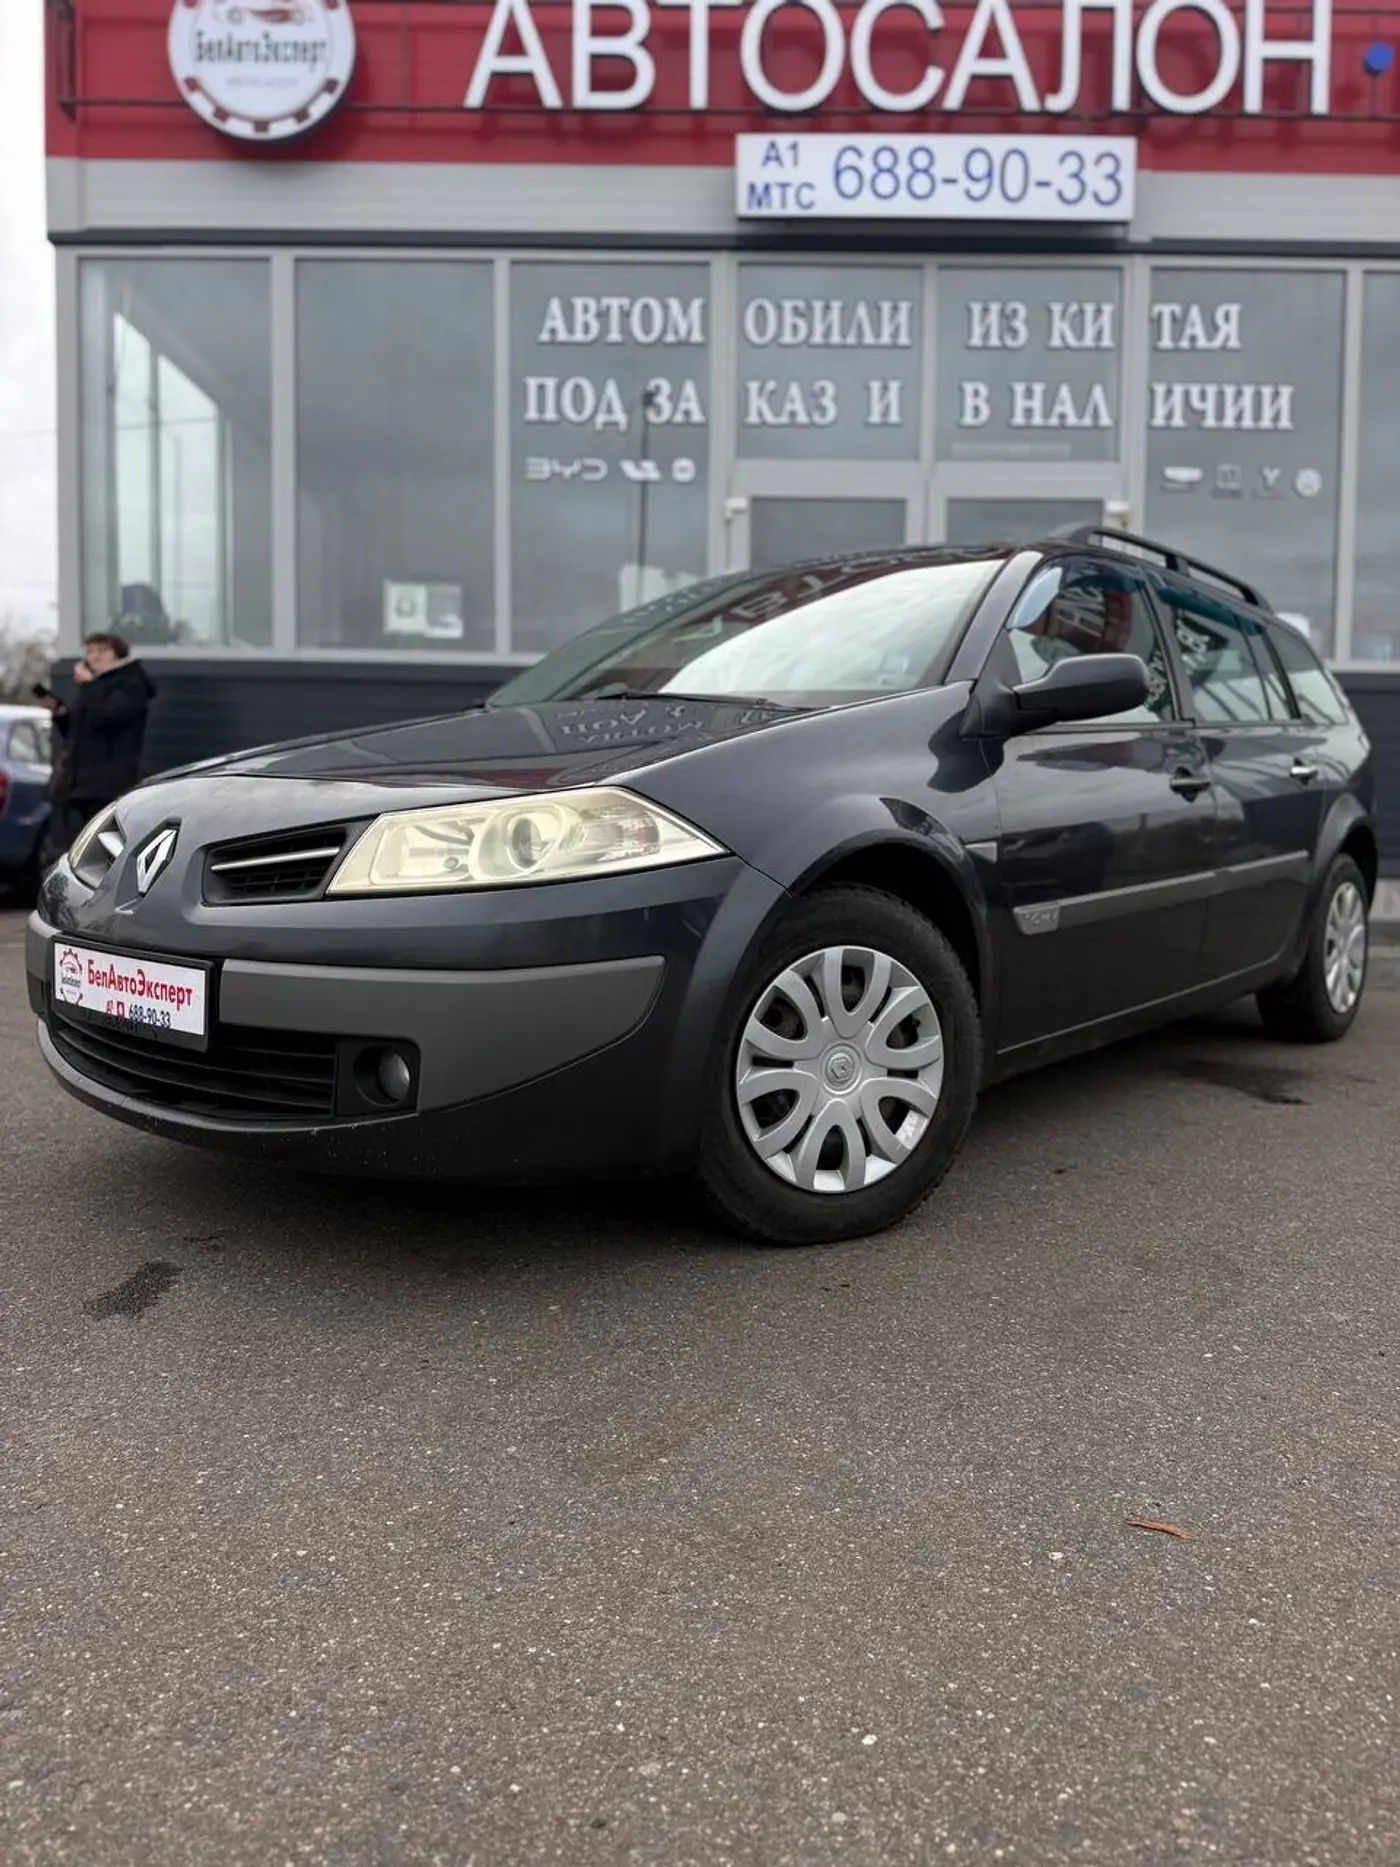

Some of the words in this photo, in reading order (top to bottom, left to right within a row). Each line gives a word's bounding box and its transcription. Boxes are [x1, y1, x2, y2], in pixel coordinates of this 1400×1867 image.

[463, 0, 1332, 114] АВТОСАЛОН
[832, 145, 1123, 206] 688-90-33
[966, 301, 1029, 348] ИЗ
[524, 376, 628, 432] ПОД
[868, 379, 901, 425] И
[960, 381, 990, 427] В
[87, 958, 194, 1012] БелАвтоЭксперт
[128, 1003, 172, 1029] 688-90-33
